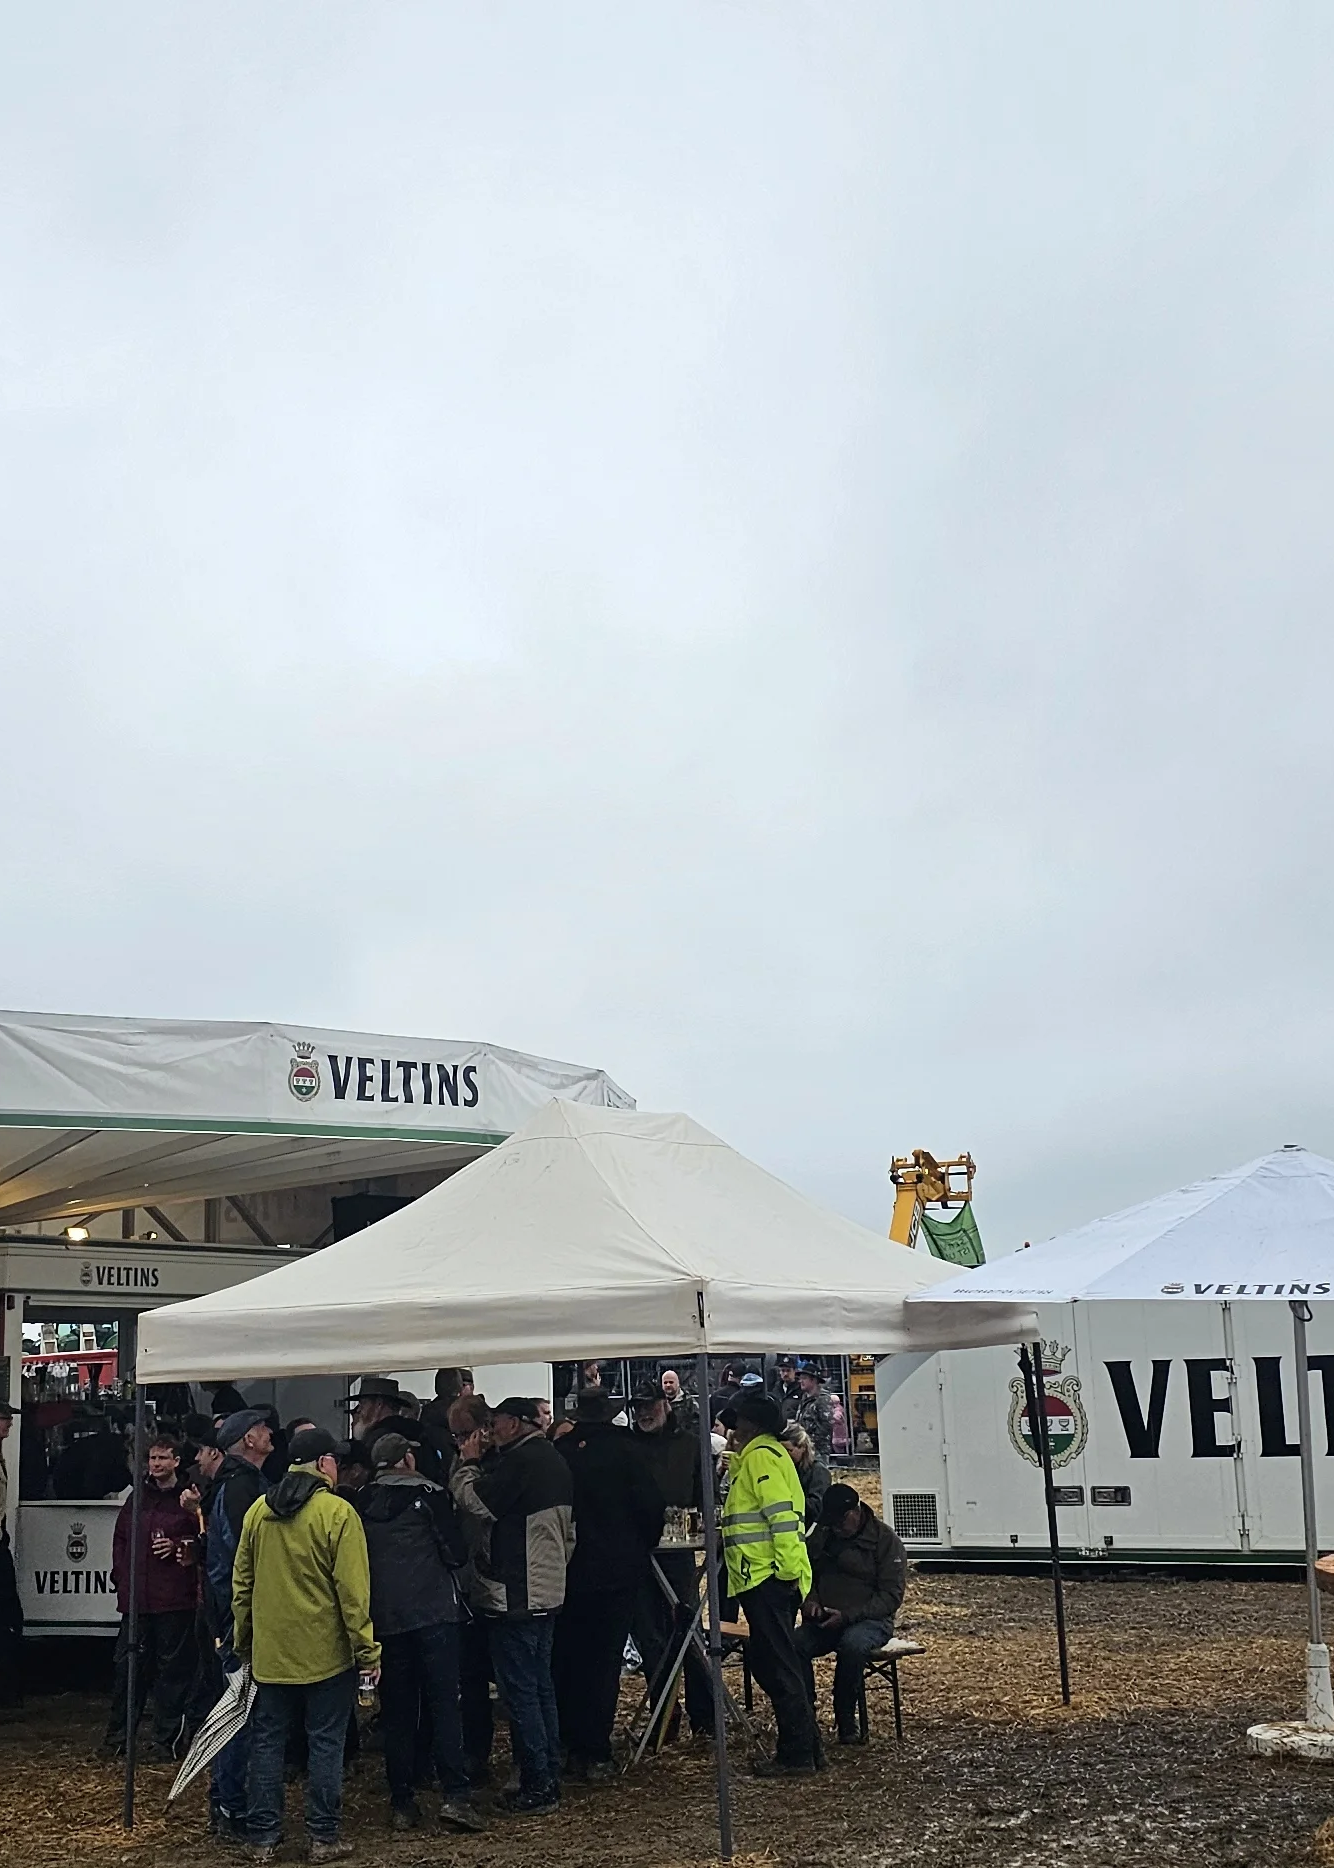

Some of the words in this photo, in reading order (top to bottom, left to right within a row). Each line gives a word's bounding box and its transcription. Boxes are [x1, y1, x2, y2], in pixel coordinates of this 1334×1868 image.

[327, 1053, 479, 1108] VELTINS
[95, 1265, 160, 1288] VELTINS
[1193, 1282, 1331, 1295] VELTINS
[34, 1570, 117, 1595] VELTINS
